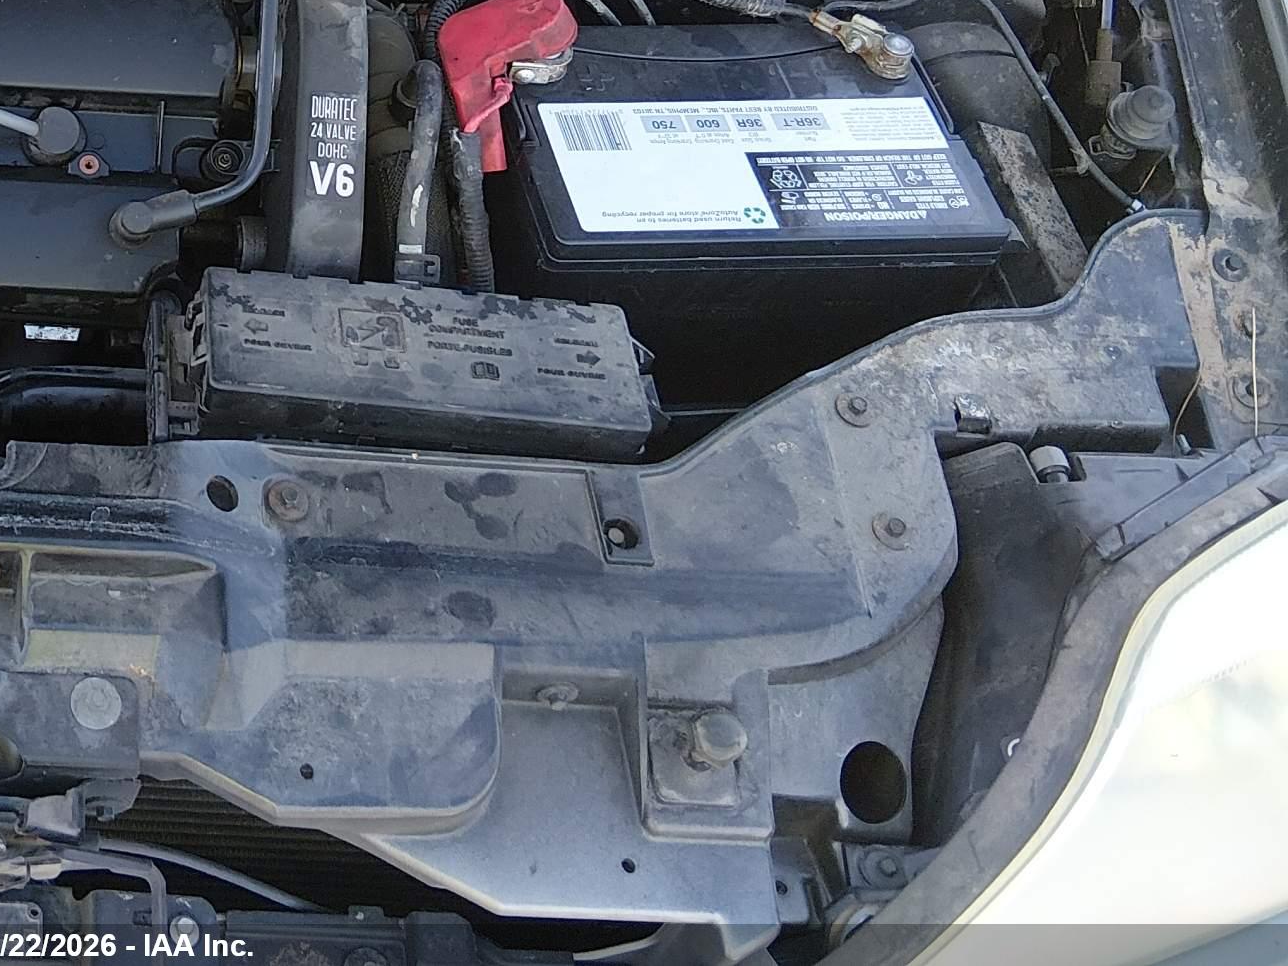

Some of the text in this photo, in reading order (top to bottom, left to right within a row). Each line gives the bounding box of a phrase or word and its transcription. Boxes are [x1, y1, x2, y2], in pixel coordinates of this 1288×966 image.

[312, 94, 358, 122] DURATEC
[650, 120, 676, 128] 750
[694, 119, 721, 127] 600
[733, 118, 763, 127] 36R
[778, 117, 822, 126] 36R-T
[311, 123, 356, 141] 24 VALVE
[318, 142, 348, 159] DOHC
[310, 161, 354, 198] V6
[822, 210, 919, 220] DANGER/POISON
